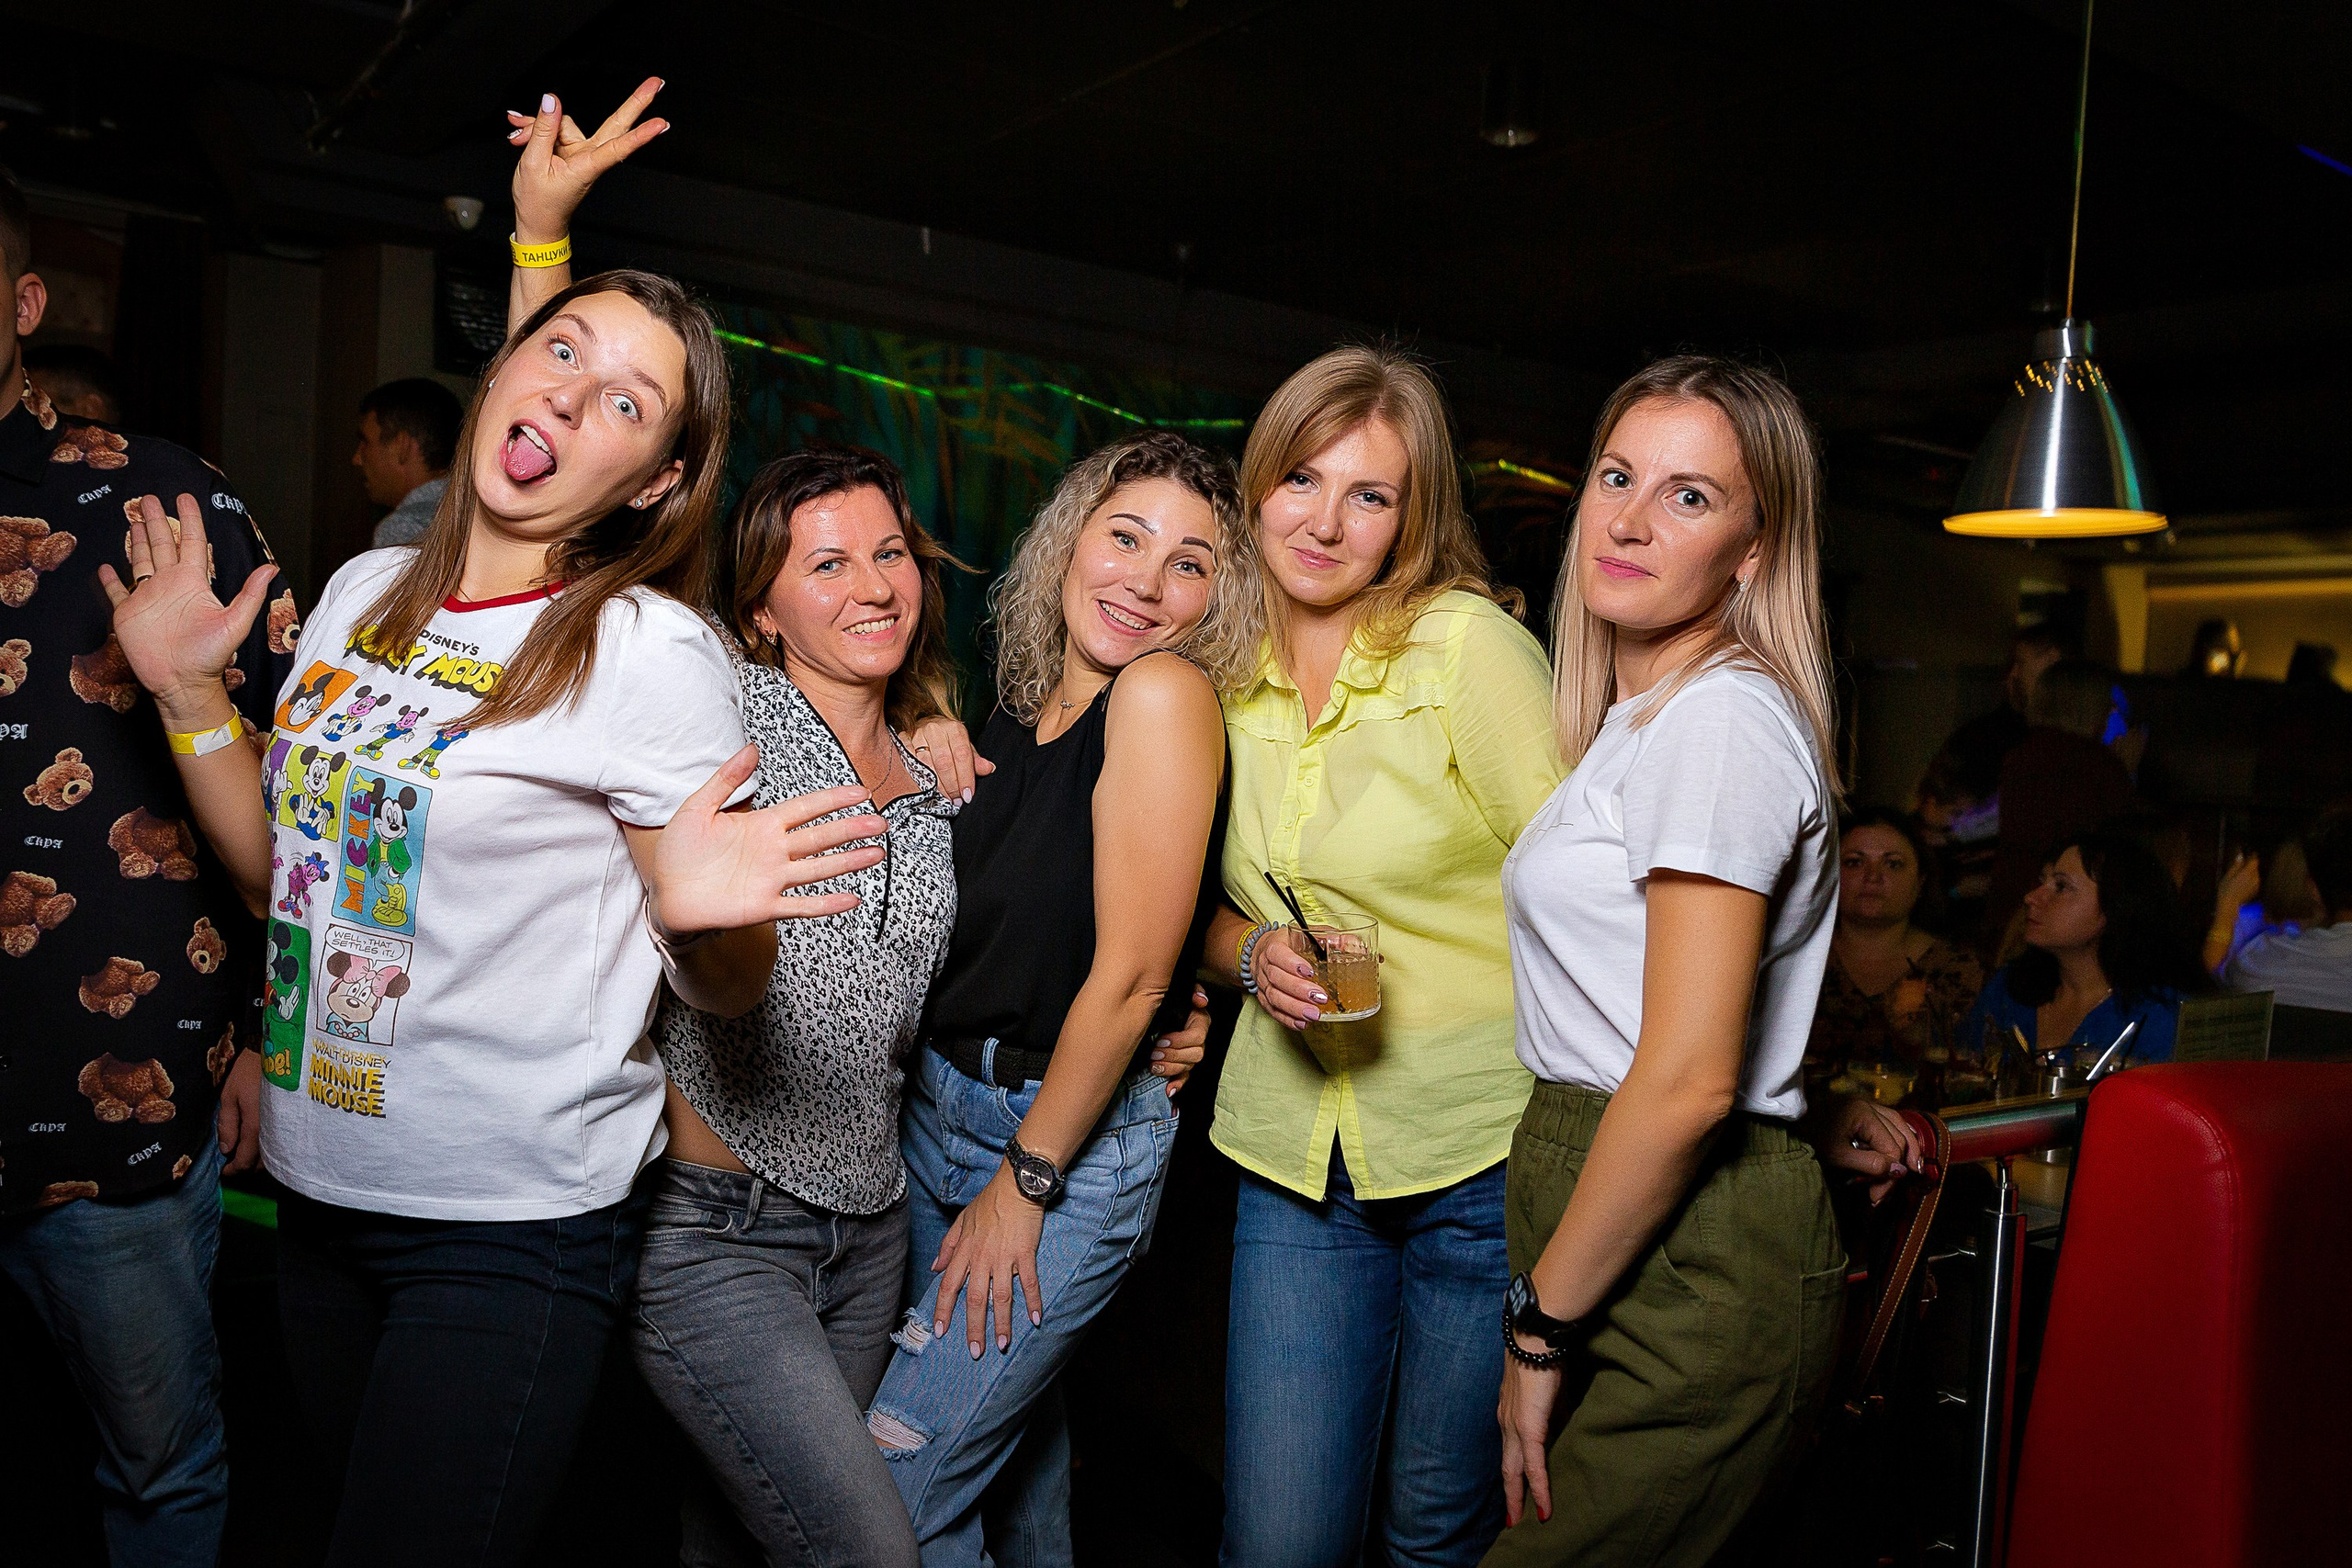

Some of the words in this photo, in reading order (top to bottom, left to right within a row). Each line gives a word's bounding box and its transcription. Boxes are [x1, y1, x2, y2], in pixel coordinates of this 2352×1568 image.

[522, 245, 568, 263] ТАНЦУКИ
[419, 629, 481, 655] DISNEY'S
[413, 652, 507, 699] MOUS
[340, 771, 376, 914] MICKEY
[332, 938, 379, 954] SETTLES
[381, 949, 396, 958] IT!
[368, 938, 393, 950] THAT
[313, 1039, 340, 1061] WALT
[340, 1048, 391, 1068] DISNEY
[310, 1053, 386, 1094] MINNIE
[308, 1076, 387, 1119] MOUSE
